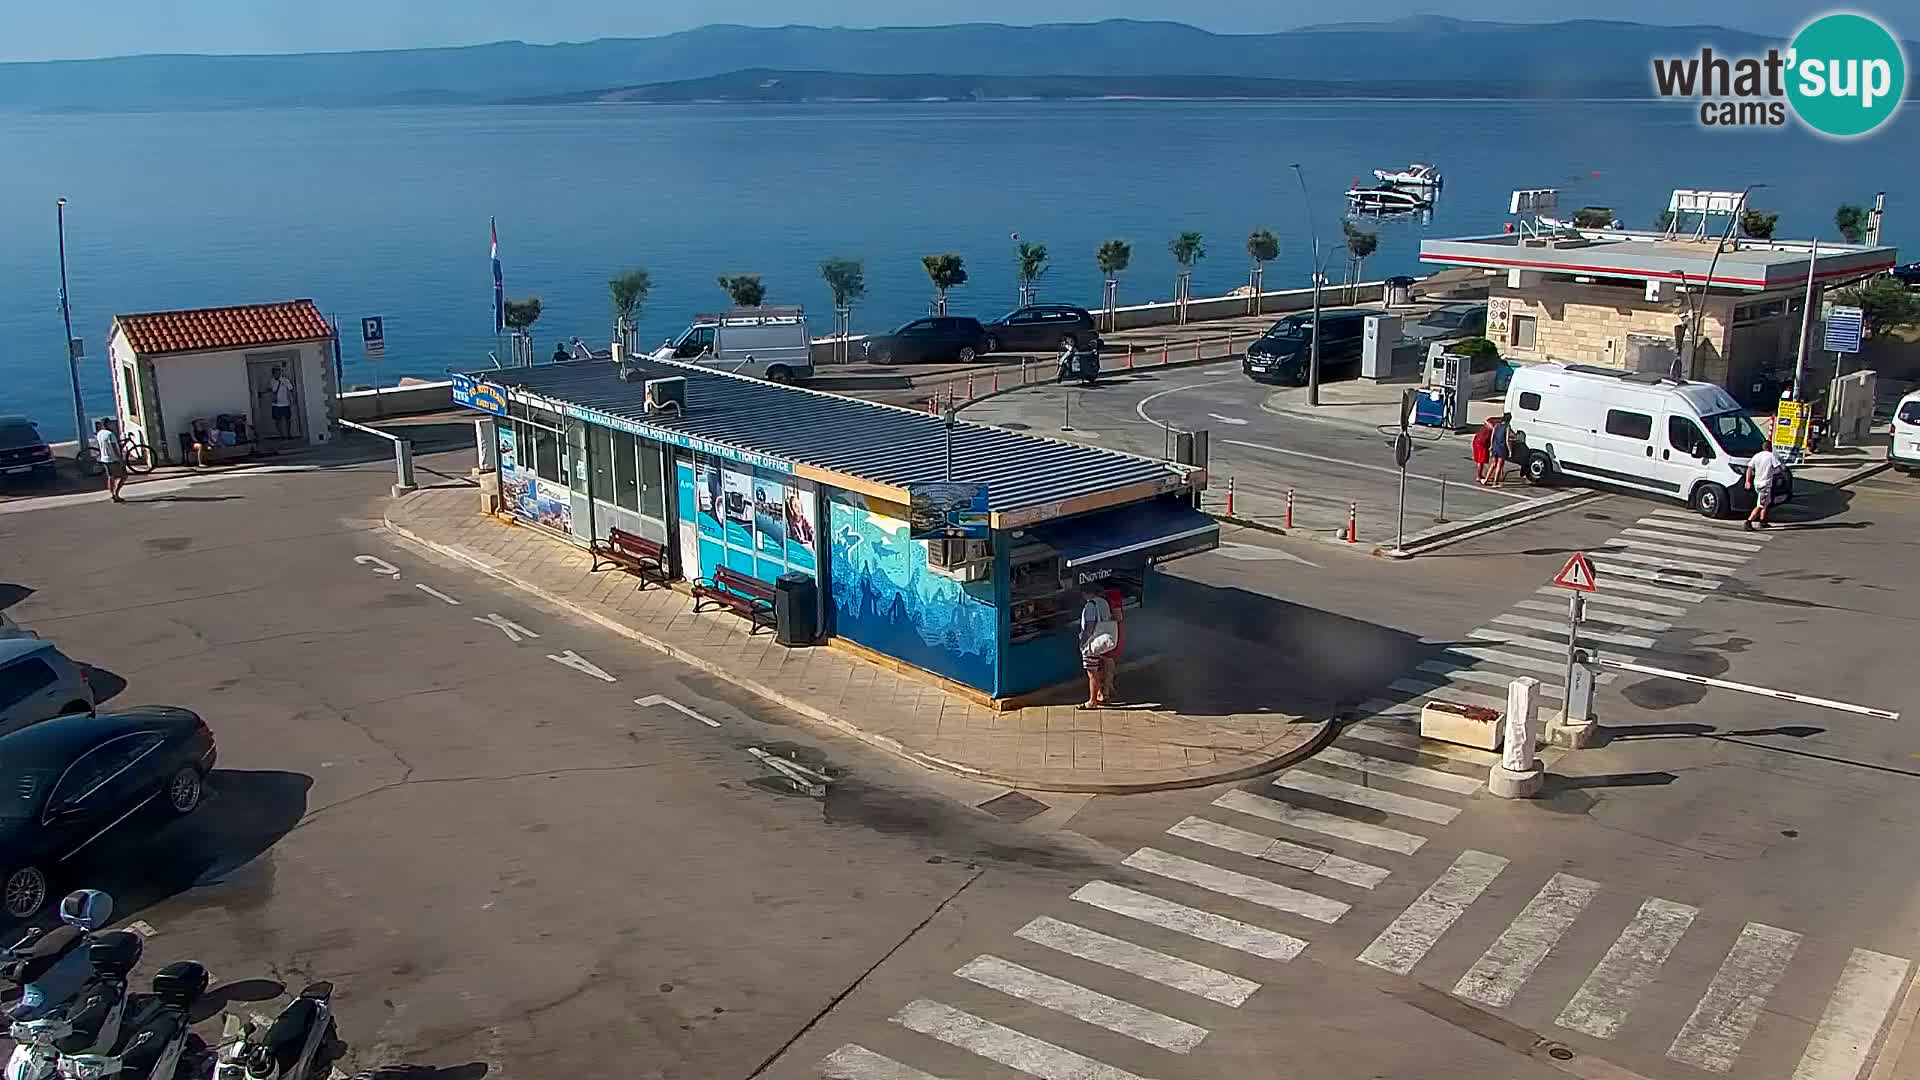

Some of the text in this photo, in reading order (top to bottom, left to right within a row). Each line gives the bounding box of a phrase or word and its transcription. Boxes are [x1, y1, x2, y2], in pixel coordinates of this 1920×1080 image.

[366, 320, 378, 338] P
[611, 418, 649, 437] AUTOBUSNA
[649, 429, 680, 443] POSTAJA
[689, 438, 703, 450] BUS
[704, 442, 735, 459] STATION
[737, 450, 762, 465] TICKET
[763, 458, 789, 471] OFFICE
